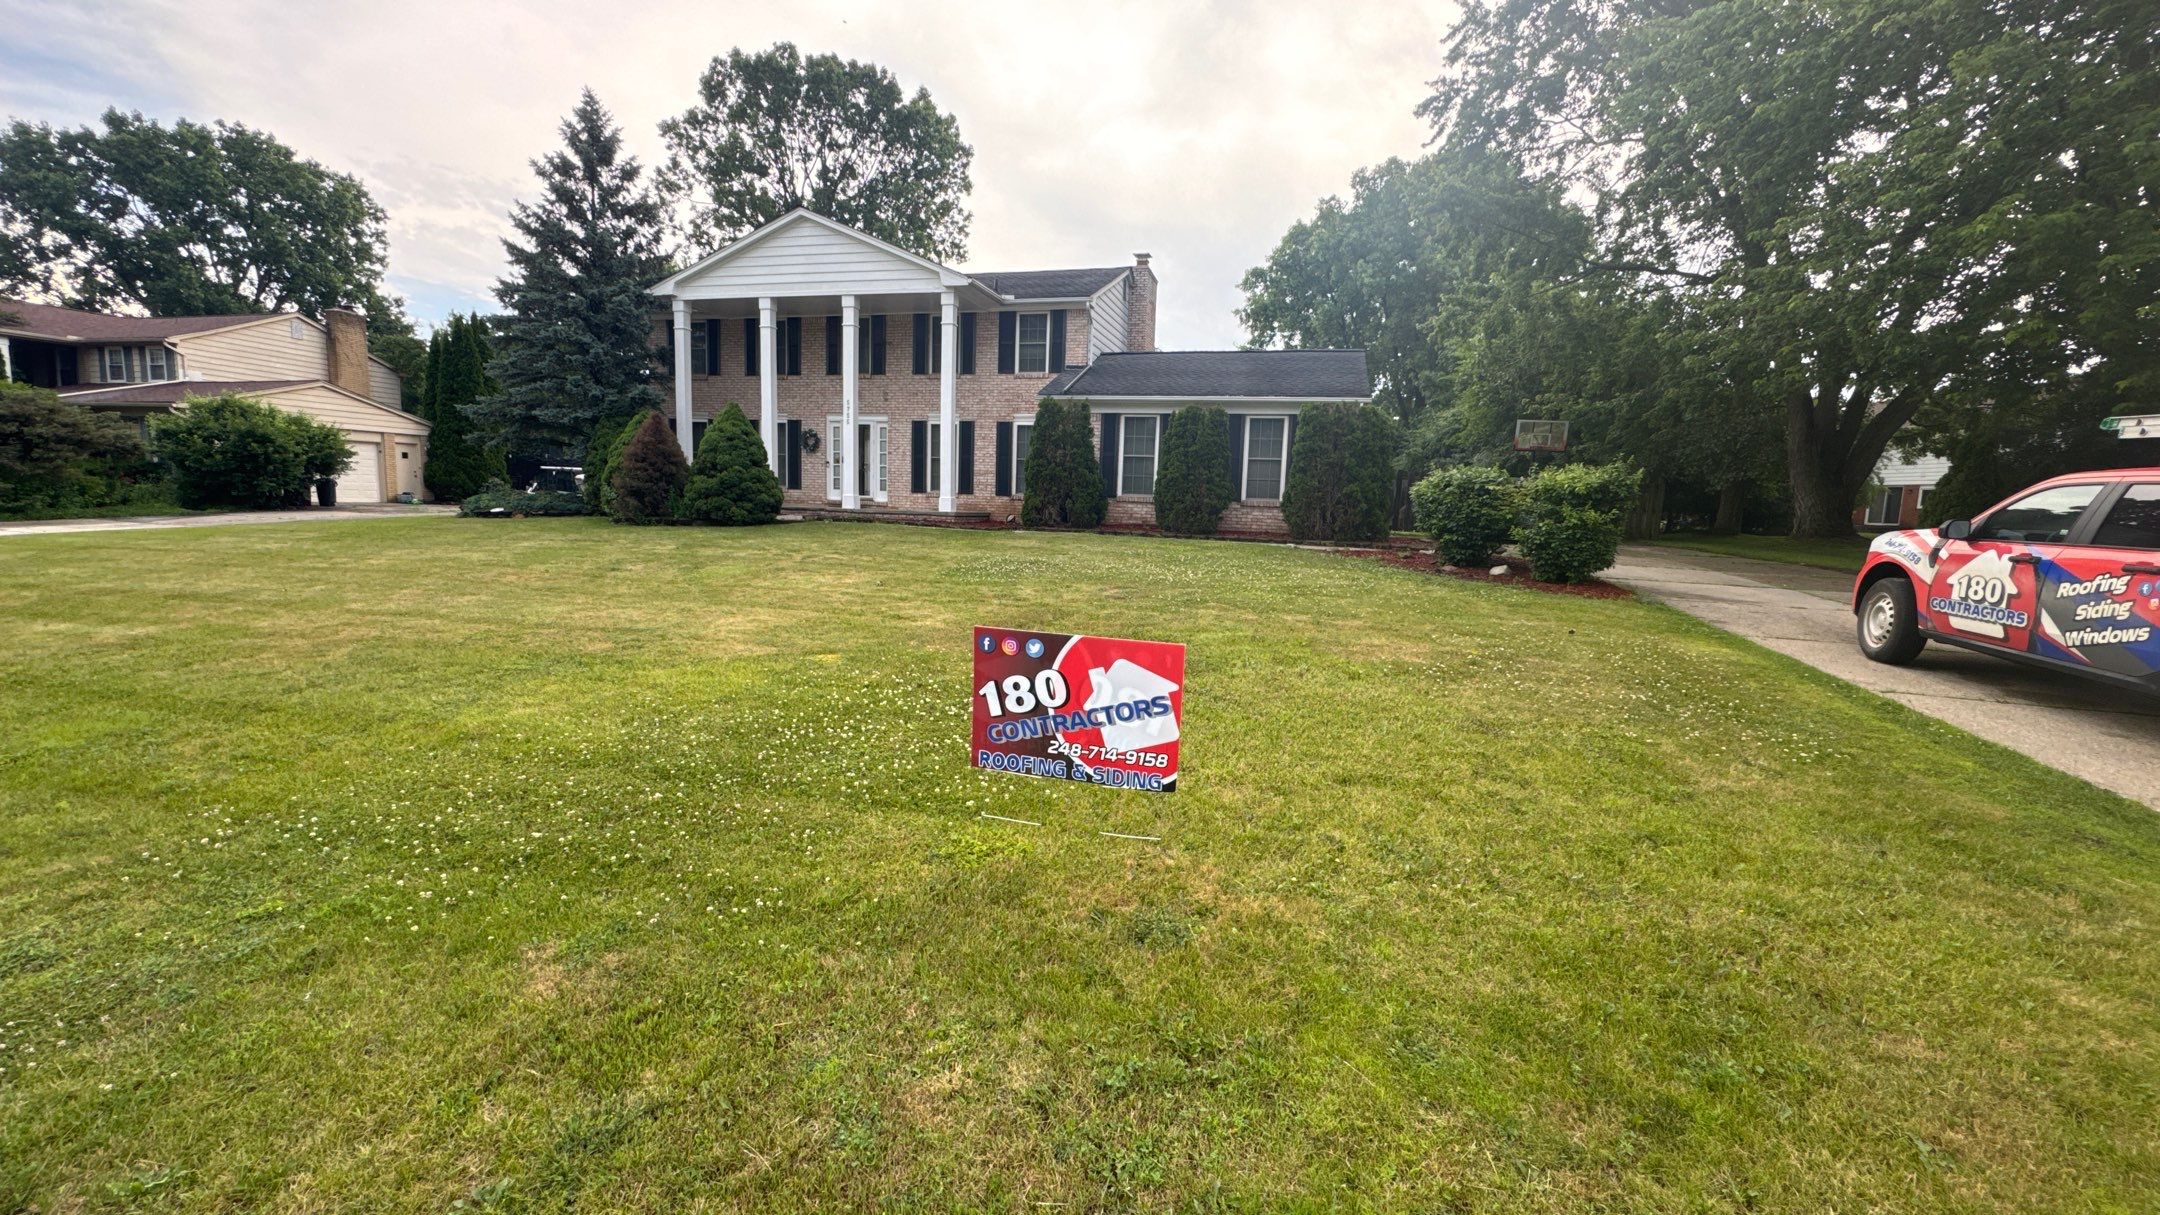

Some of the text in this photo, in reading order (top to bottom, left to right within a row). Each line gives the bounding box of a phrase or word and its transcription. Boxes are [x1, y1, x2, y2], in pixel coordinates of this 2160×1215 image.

[1958, 575, 2004, 605] 180
[2056, 574, 2131, 598] Roofing
[1930, 597, 2028, 627] CONTRACTORS
[2075, 599, 2133, 620] Siding
[2065, 626, 2150, 646] Windows
[978, 669, 1069, 717] 180
[987, 695, 1172, 744] CONTRACTORS
[1047, 740, 1169, 768] 248-714-9158
[978, 750, 1163, 791] ROOFING & SIDING
